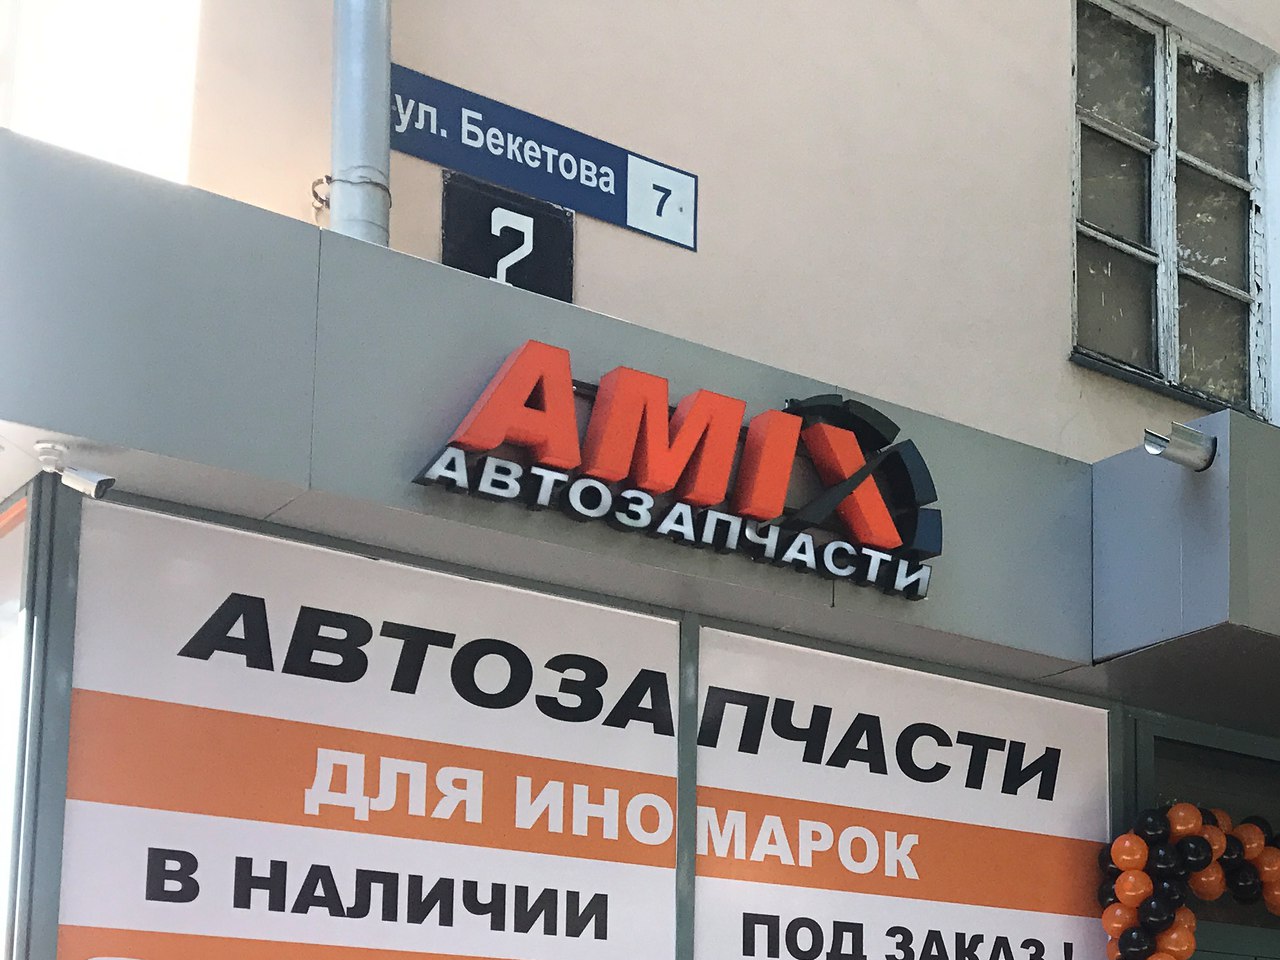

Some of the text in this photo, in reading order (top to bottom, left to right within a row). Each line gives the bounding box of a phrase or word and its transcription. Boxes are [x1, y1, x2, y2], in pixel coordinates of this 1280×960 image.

[394, 93, 617, 195] ул. Бекетова
[490, 207, 534, 287] 7
[651, 184, 673, 218] 7
[446, 339, 903, 551] AMIX
[426, 446, 932, 600] АВТОЗАПЧАСТИ
[304, 747, 484, 823] ДЛЯ
[145, 847, 609, 940] В НАЛИЧИИ
